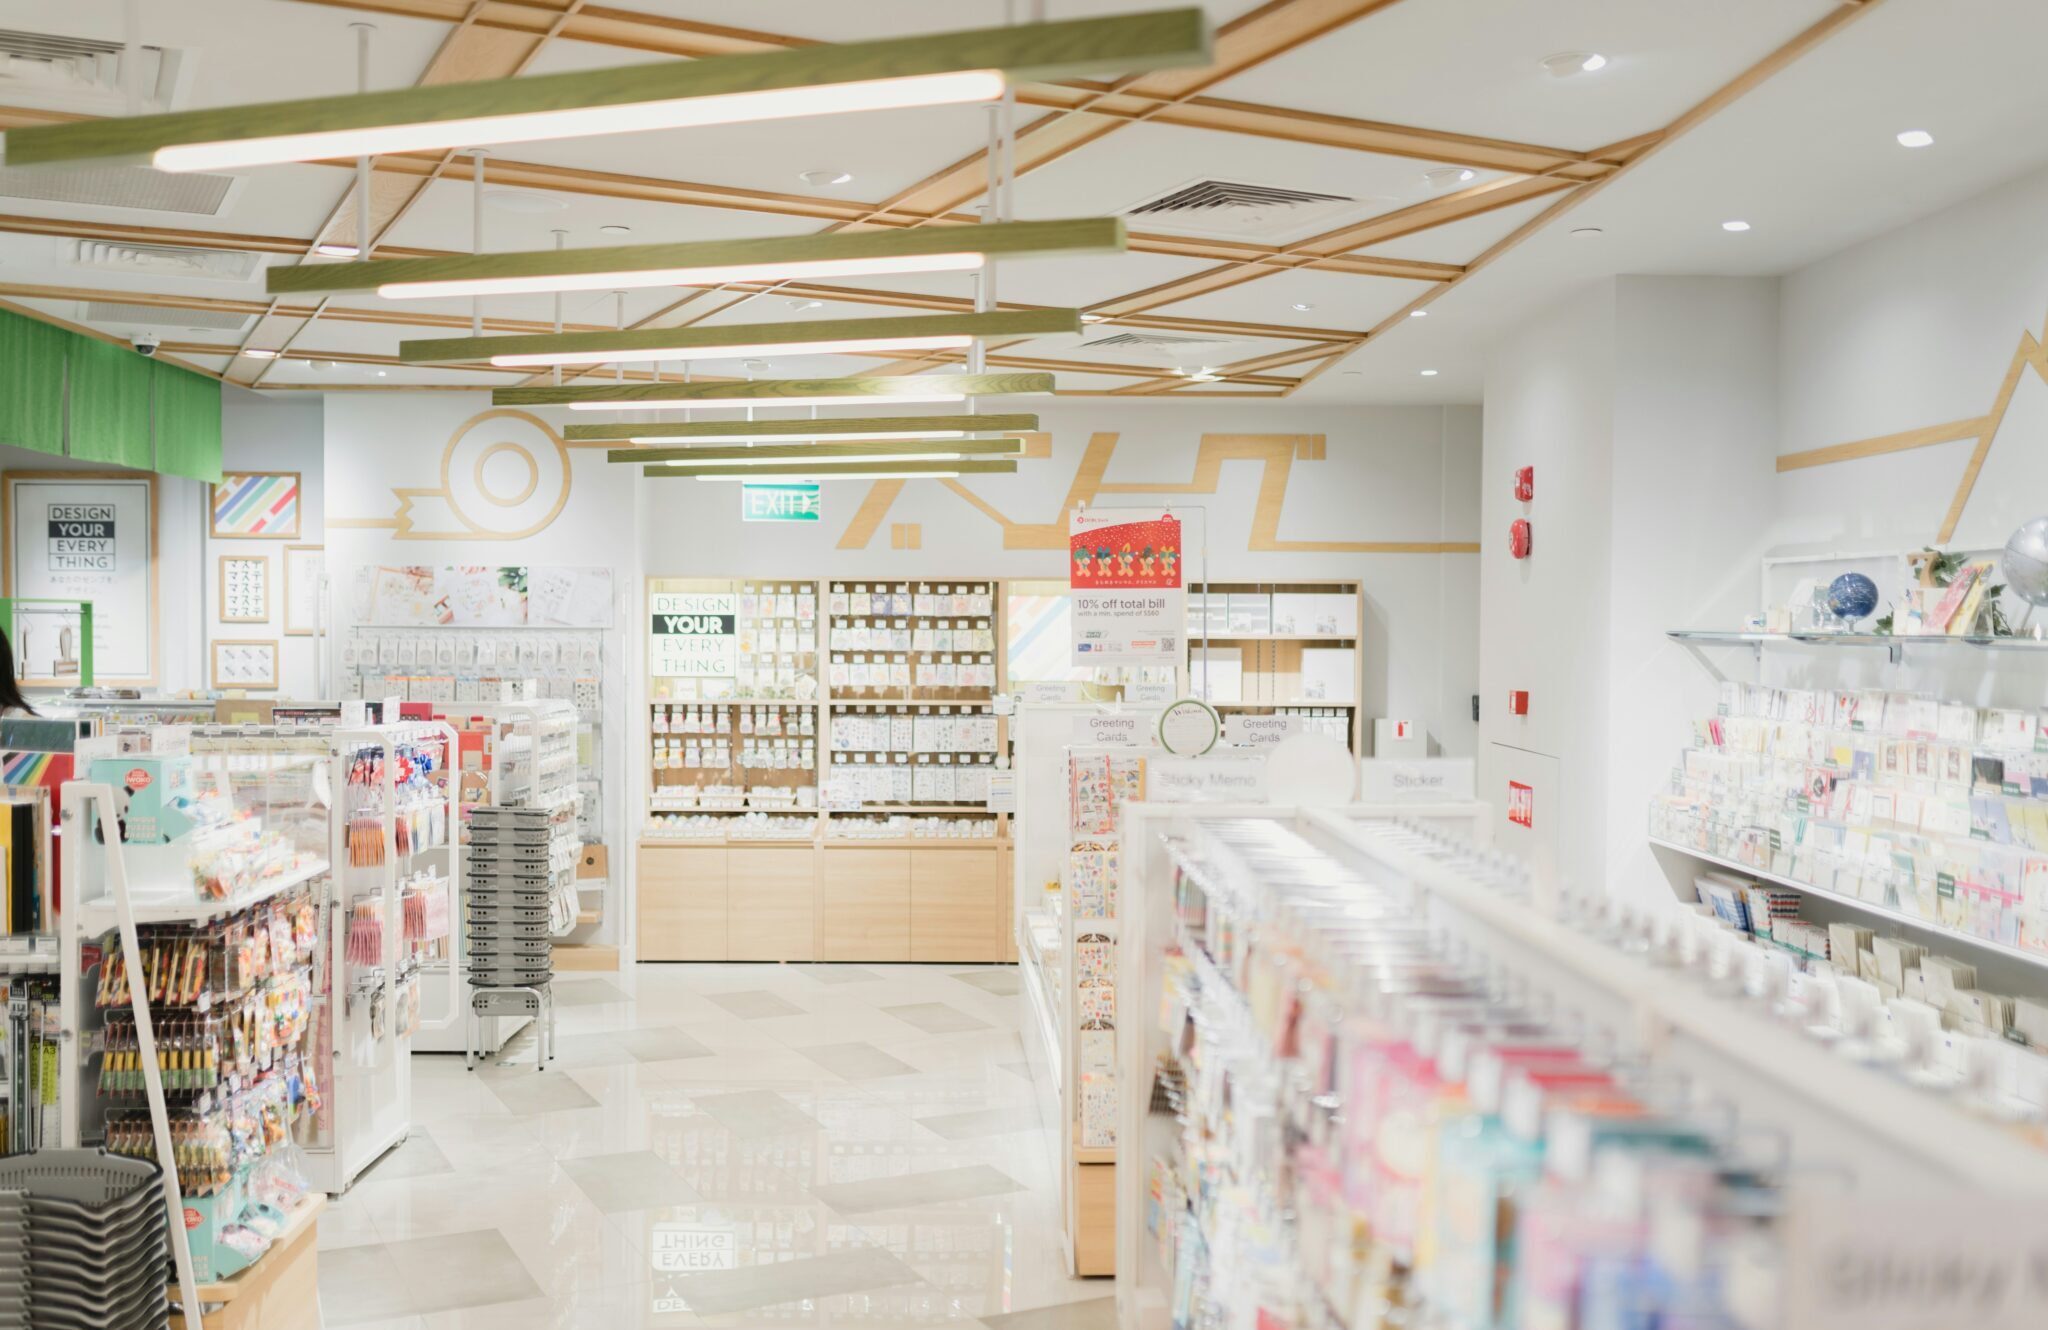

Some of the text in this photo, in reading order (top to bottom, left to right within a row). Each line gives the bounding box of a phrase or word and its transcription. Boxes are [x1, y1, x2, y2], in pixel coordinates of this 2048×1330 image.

[751, 489, 797, 515] EXIT
[52, 506, 111, 520] DESIGN
[58, 522, 105, 537] YOUR
[57, 539, 107, 552] EVERY
[55, 555, 108, 569] THING
[657, 597, 730, 612] DESIGN
[1078, 598, 1165, 609] 10% off total bill
[1113, 610, 1134, 618] spend
[663, 615, 723, 634] YOUR
[663, 638, 724, 653] EVERY
[662, 658, 726, 673] THING
[1036, 684, 1066, 693] Greeting
[1136, 684, 1165, 693] Greeting
[1089, 718, 1135, 729] Greeting
[1242, 718, 1287, 730] Greeting
[1096, 732, 1128, 742] Cards
[1249, 732, 1281, 743] Cards
[1160, 772, 1257, 787] Sticky Memo
[1393, 773, 1445, 789] Sticker
[43, 1047, 56, 1055] A3
